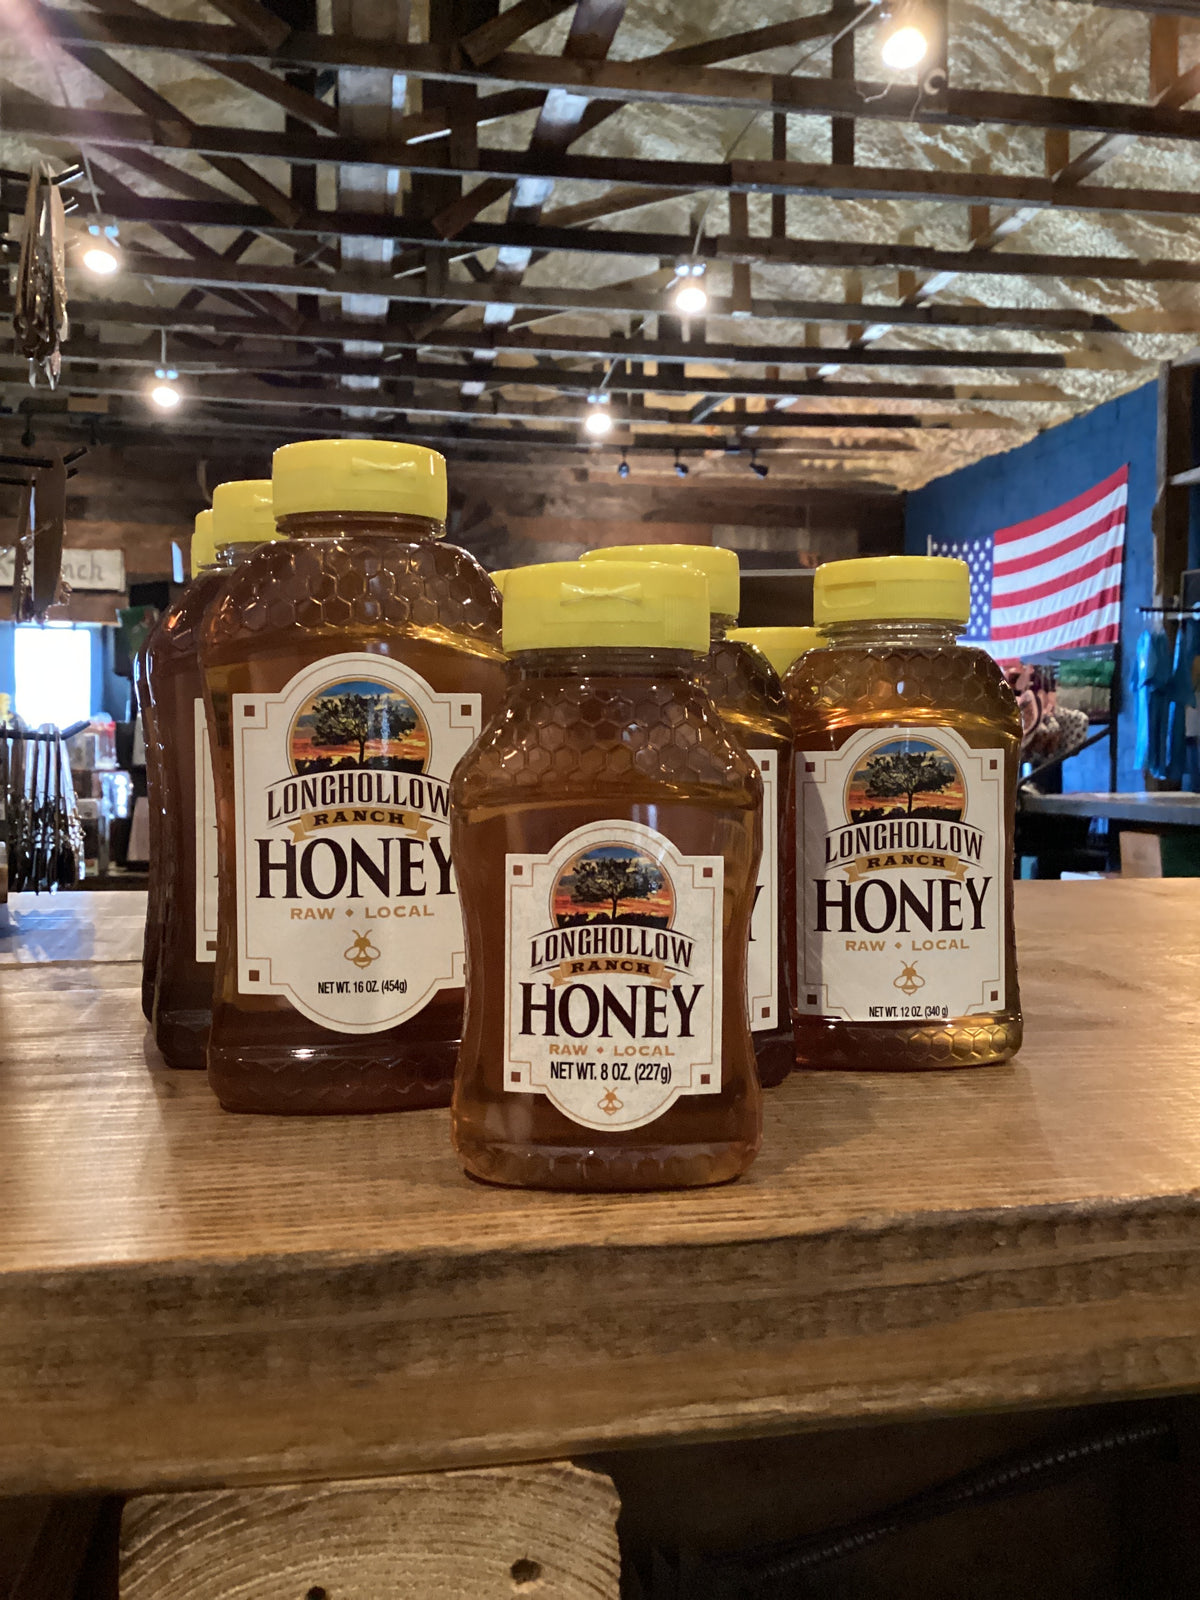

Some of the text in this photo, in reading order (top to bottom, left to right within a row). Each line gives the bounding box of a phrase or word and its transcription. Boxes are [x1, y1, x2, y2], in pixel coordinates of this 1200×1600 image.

[267, 772, 450, 822] LONGHOLLOW
[313, 810, 406, 826] RANCH
[825, 821, 983, 863] LONGHOLLOW
[254, 836, 456, 899] HONEY
[866, 854, 946, 868] RANCH
[290, 905, 434, 920] RAW LOCAL
[813, 877, 992, 934] HONEY
[530, 927, 694, 968] LONGHOLLOW
[845, 938, 970, 952] RAW LOCAL
[570, 960, 650, 974] RANCH
[318, 979, 408, 995] NET WT. 16 OZ. (454g)
[518, 982, 705, 1039] HONEY
[869, 1006, 883, 1017] NET
[885, 1006, 898, 1017] WT.
[901, 1006, 909, 1017] 12
[911, 1006, 923, 1017] OZ.
[549, 1044, 675, 1056] RAW LOCAL
[550, 1061, 672, 1085] NET WT. 8 OZ. (227g)
